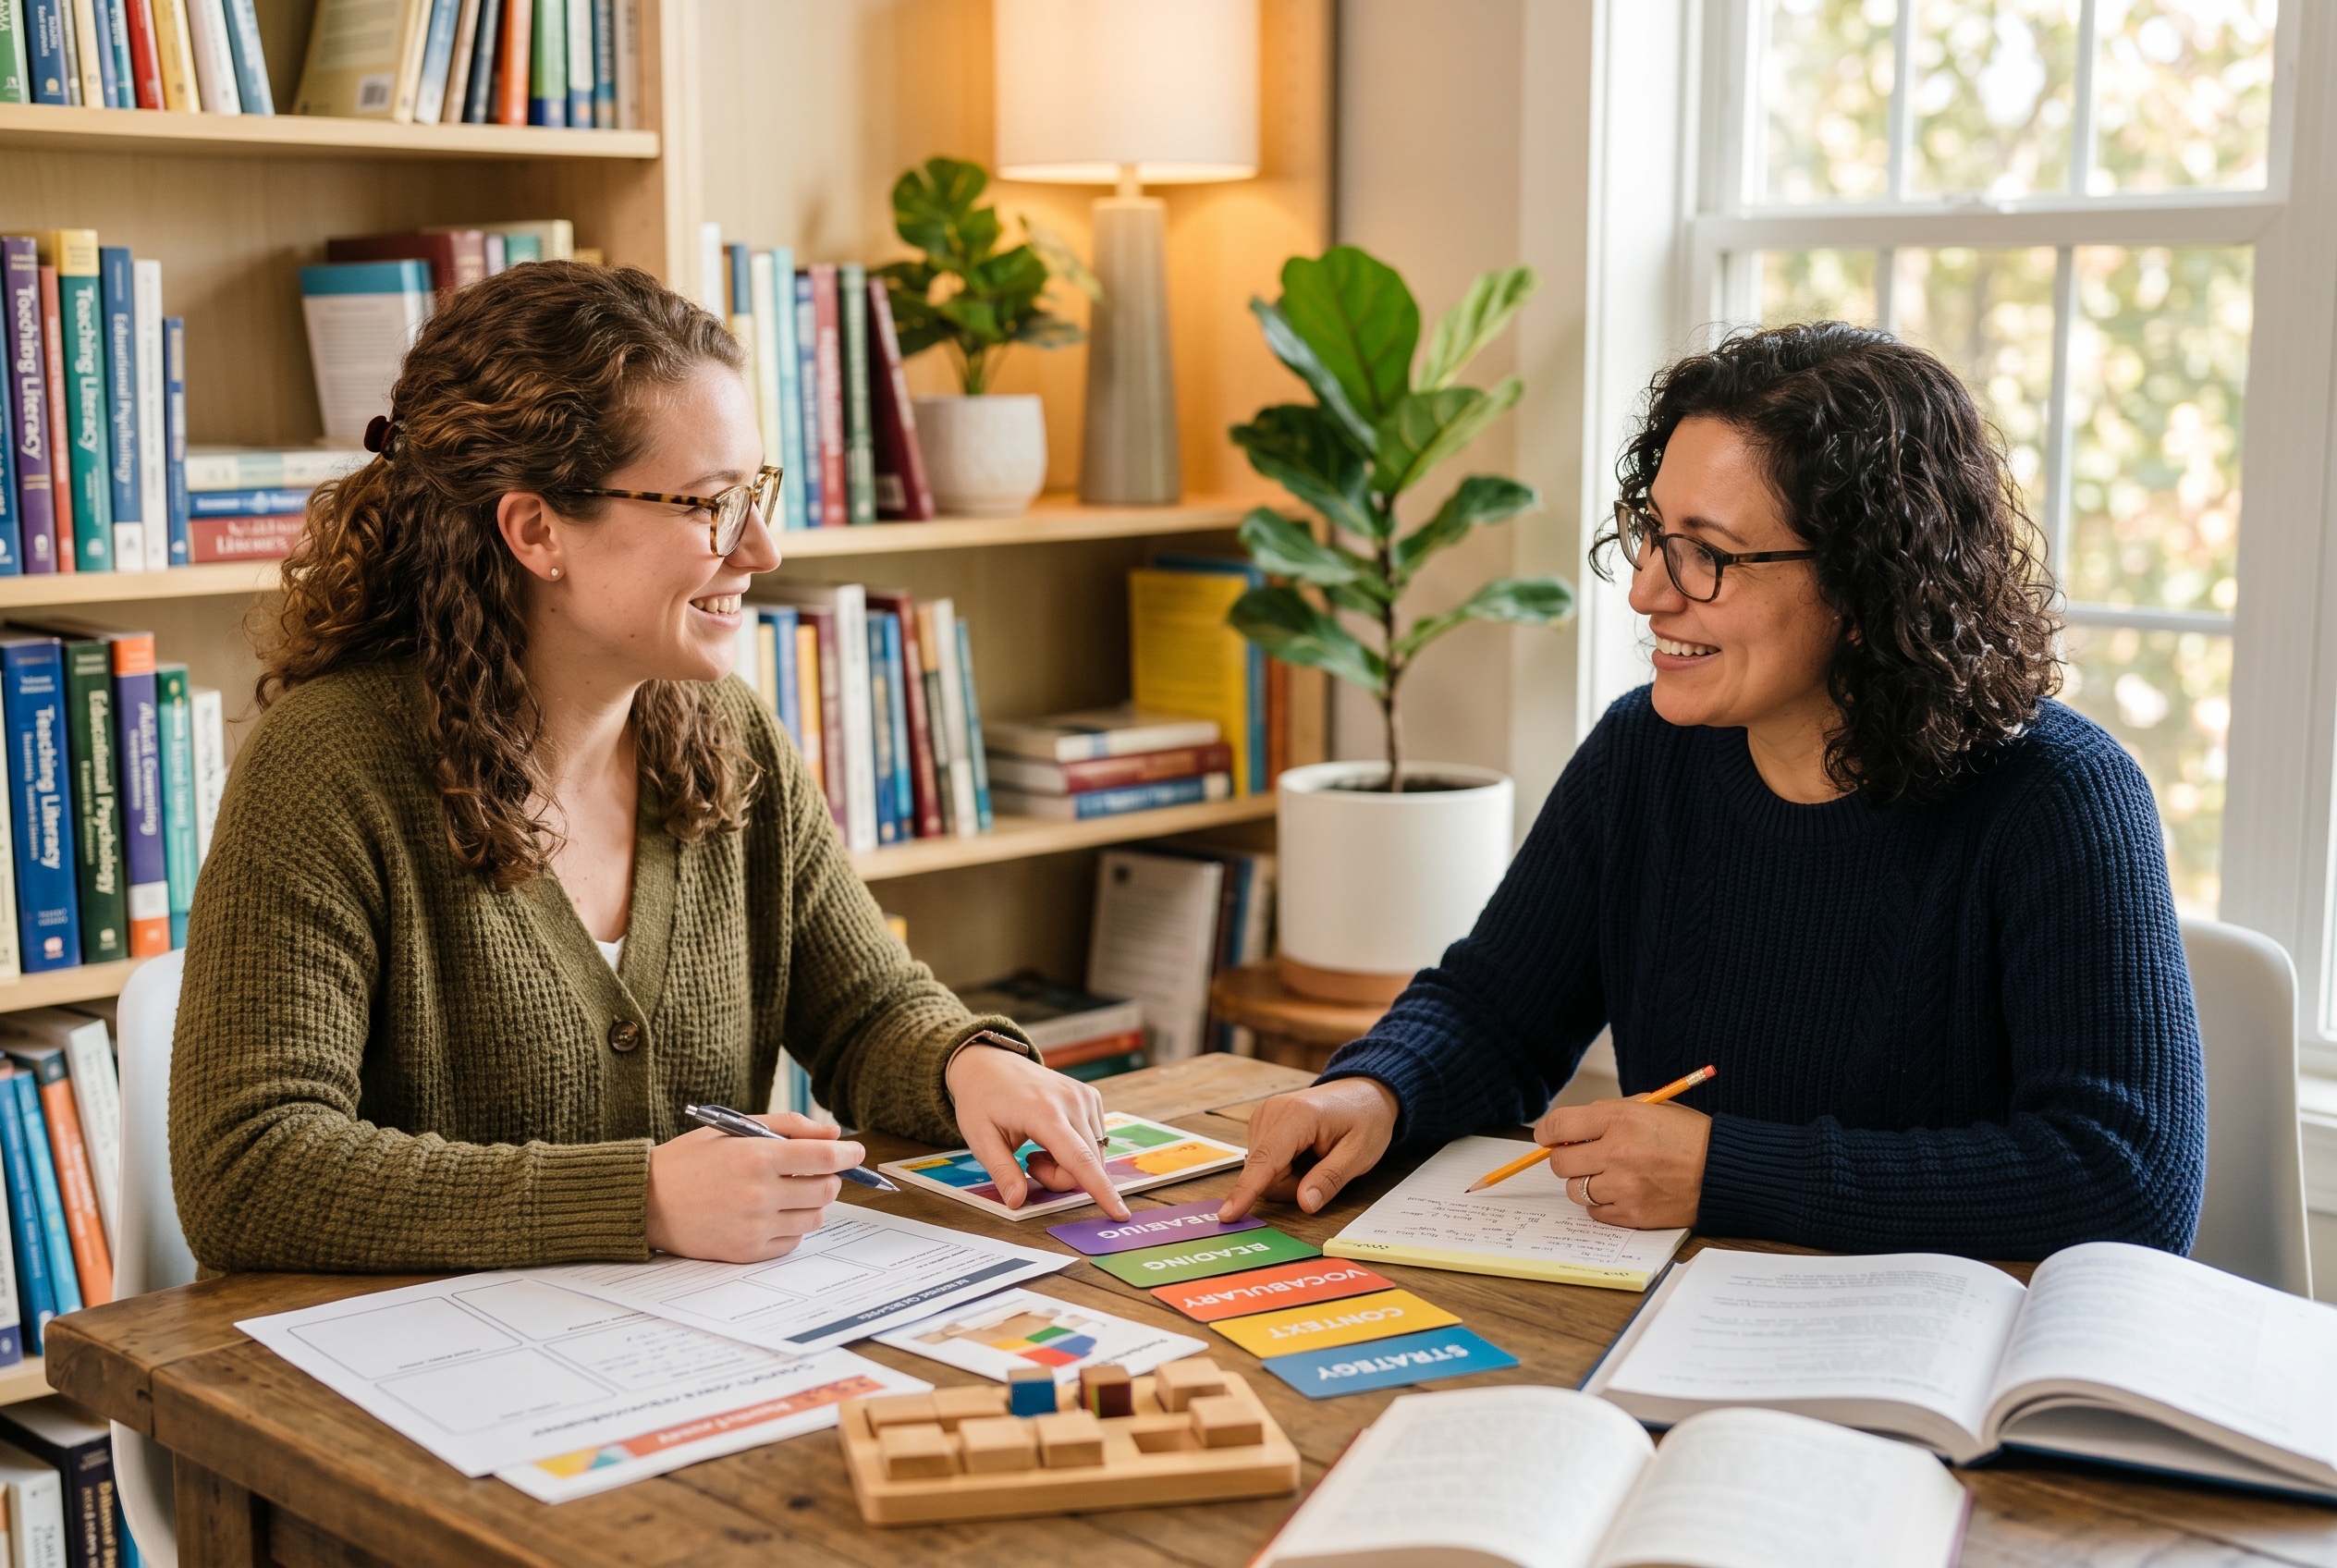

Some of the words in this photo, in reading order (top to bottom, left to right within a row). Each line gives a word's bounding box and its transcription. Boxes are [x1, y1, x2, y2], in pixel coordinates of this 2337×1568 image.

[75, 285, 97, 374] Teaching
[35, 705, 56, 792] Teaching
[89, 690, 113, 793] Educational
[41, 795, 62, 868] Literacy
[93, 796, 116, 894] Psychology
[1181, 1269, 1368, 1307] VOCABULARY
[1267, 1306, 1404, 1340] CONTEXT
[1316, 1343, 1469, 1380] STRATEGY
